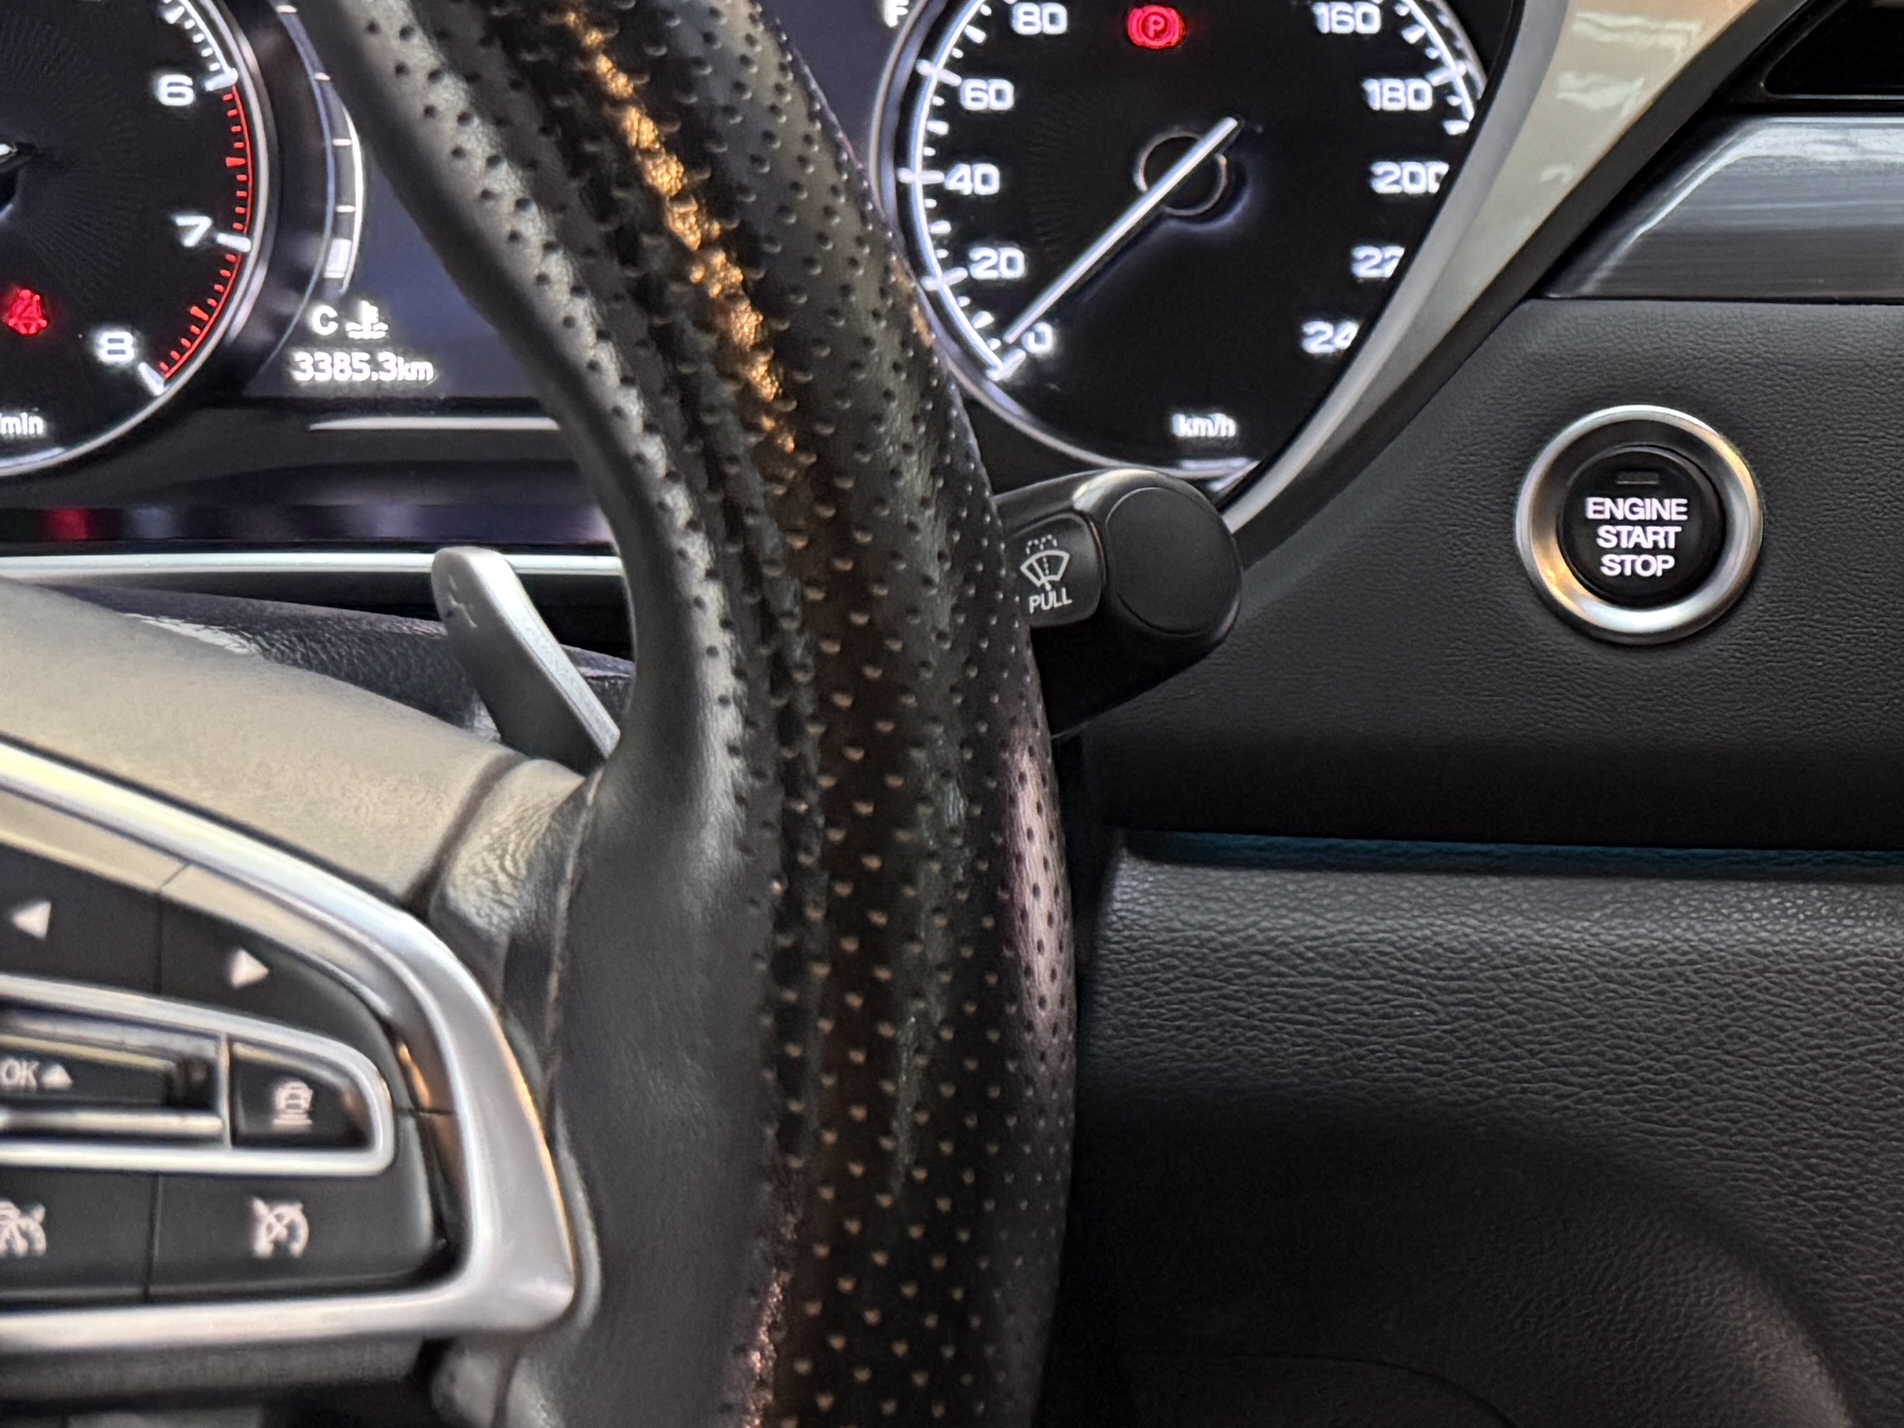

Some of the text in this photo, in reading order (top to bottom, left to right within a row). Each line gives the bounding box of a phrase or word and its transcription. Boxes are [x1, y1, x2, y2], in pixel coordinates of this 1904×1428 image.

[1011, 2, 1069, 36] 80
[1312, 1, 1382, 35] 160
[157, 75, 194, 106] 6
[959, 78, 1016, 112] 60
[1361, 78, 1433, 112] 180
[943, 163, 1001, 196] 40
[174, 215, 212, 247] 7
[967, 248, 1026, 281] 20
[1351, 245, 1406, 280] 22
[313, 305, 338, 335] C
[96, 331, 136, 363] 8
[1023, 322, 1054, 353] 0
[1301, 321, 1361, 356] 24
[1170, 414, 1237, 440] km/h
[1585, 497, 1689, 521] ENGINE
[1596, 525, 1682, 550] START
[1600, 554, 1676, 578] STOP
[1029, 587, 1073, 613] PULL
[1, 1058, 39, 1089] OK
